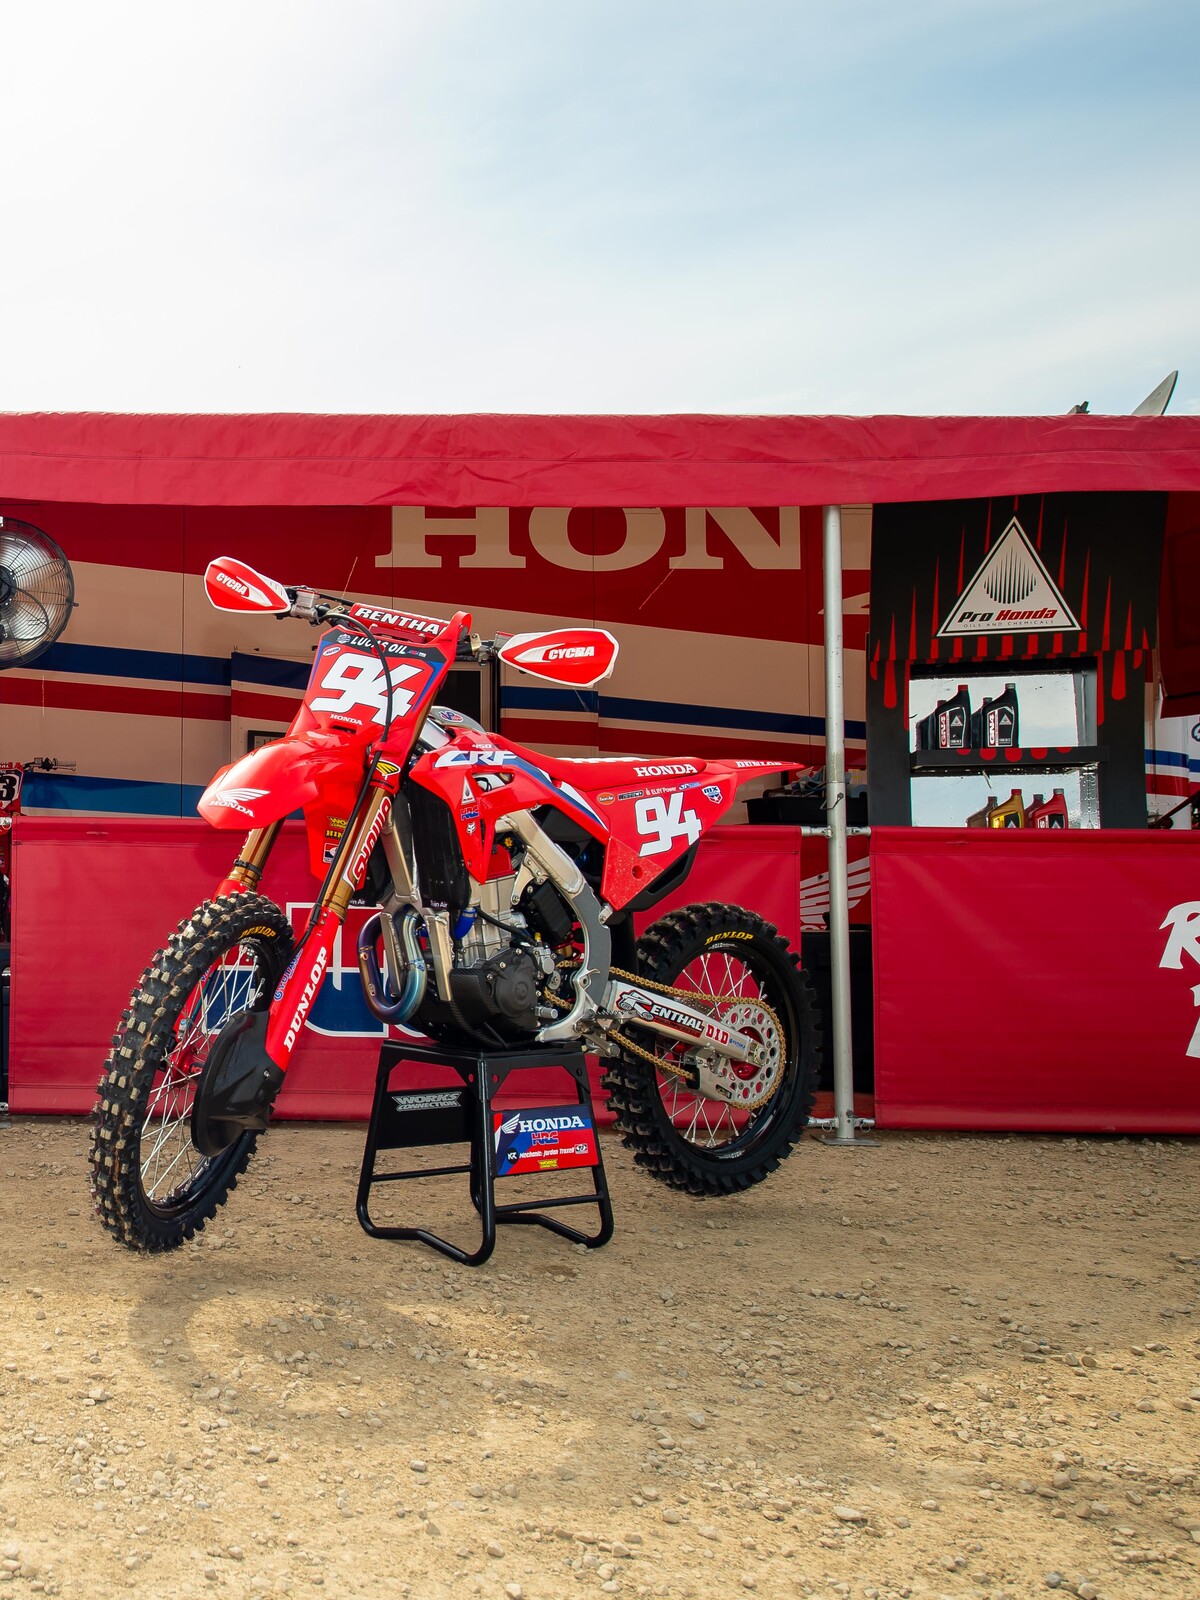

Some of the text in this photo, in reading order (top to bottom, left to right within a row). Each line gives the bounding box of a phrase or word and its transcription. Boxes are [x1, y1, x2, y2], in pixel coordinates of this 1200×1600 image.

[375, 506, 870, 571] HON
[216, 572, 247, 596] CYCRA
[355, 608, 448, 635] RENTHA
[958, 608, 1058, 623] Pro Honda
[351, 636, 389, 652] LUCS
[388, 643, 407, 655] OIL
[548, 646, 595, 660] CYCRA
[309, 652, 423, 726] 94
[330, 714, 363, 726] HONDA
[434, 750, 517, 768] CRF
[633, 763, 698, 777] HONDA
[663, 786, 676, 794] Power
[208, 800, 254, 818] HONDA
[635, 792, 702, 857] 94
[326, 829, 344, 838] HIN
[238, 925, 277, 940] DUNLOP
[704, 931, 754, 946] DUNLOP
[283, 946, 328, 1052] DUNLOP
[396, 1093, 459, 1105] WORKS
[397, 1101, 458, 1110] CONNECTION
[518, 1115, 586, 1133] HONDA
